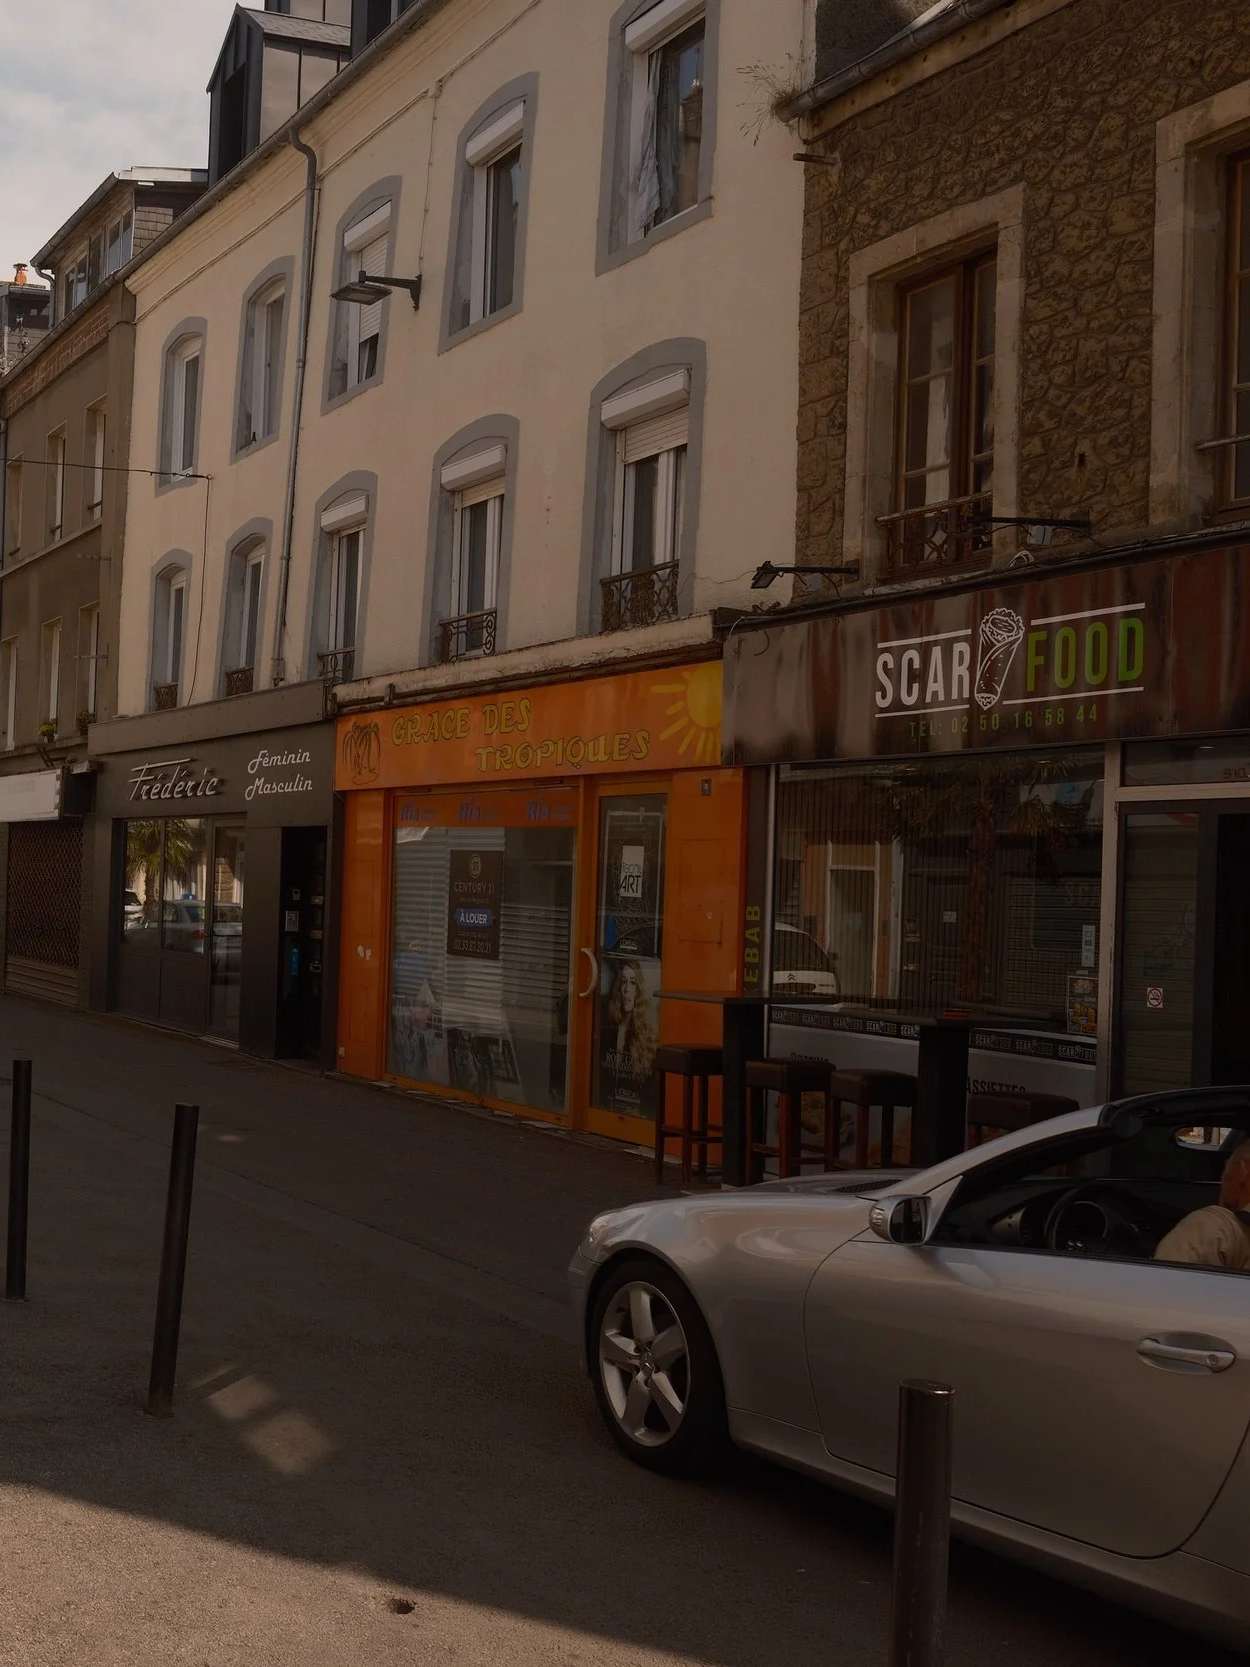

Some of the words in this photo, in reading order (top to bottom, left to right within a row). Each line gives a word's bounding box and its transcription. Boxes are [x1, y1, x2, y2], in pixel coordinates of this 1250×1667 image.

[875, 640, 971, 709] SCAR
[1026, 617, 1145, 693] FOOD
[391, 707, 470, 746] GRACE
[482, 697, 533, 735] DES
[951, 715, 969, 734] 02
[979, 712, 1000, 732] 50
[1013, 711, 1033, 729] 16
[1045, 707, 1065, 726] 58
[1076, 703, 1098, 723] 44
[475, 729, 650, 773] TROPIQUES
[128, 757, 219, 800] Frédéric
[247, 748, 311, 774] Féminin
[244, 773, 313, 800] Masculin
[453, 881, 487, 894] CENTURY
[619, 874, 642, 894] ART
[459, 908, 465, 922] À
[466, 912, 488, 925] LOUER
